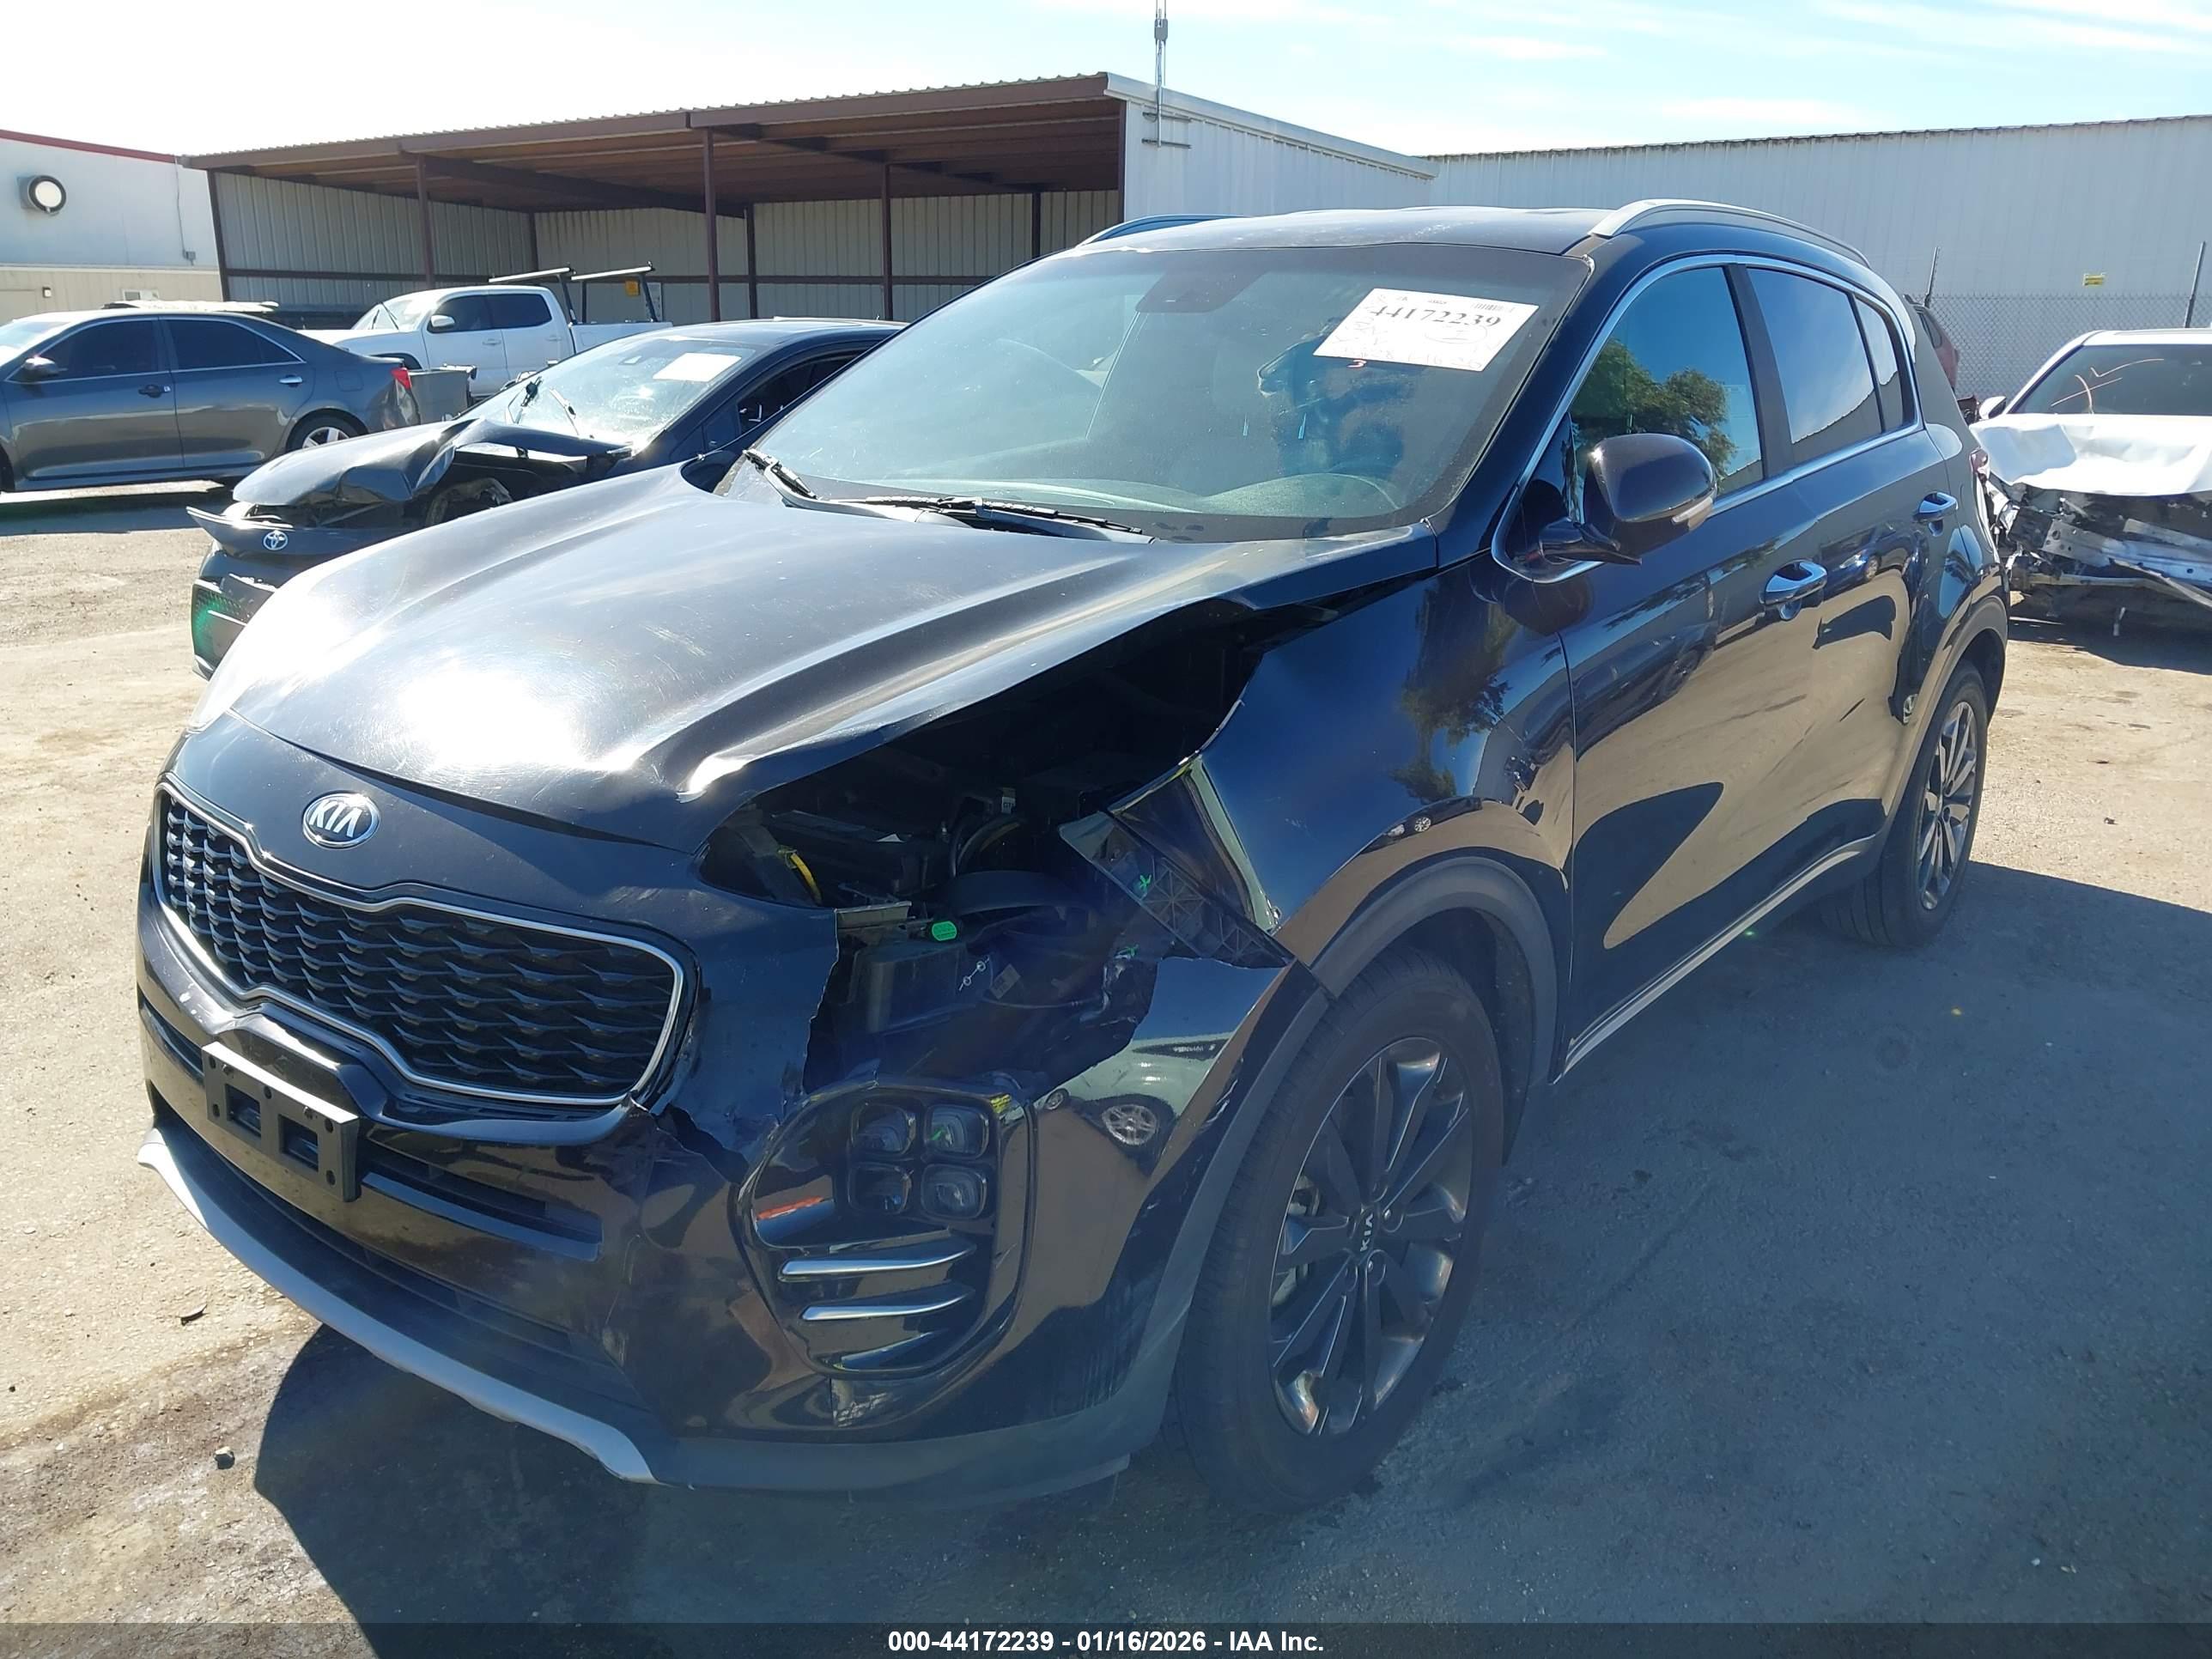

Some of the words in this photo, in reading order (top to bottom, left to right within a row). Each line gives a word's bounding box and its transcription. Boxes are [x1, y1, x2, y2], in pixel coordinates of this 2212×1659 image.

[1370, 305, 1502, 327] 44172239
[308, 799, 363, 838] KIA
[1359, 1212, 1374, 1252] KIA
